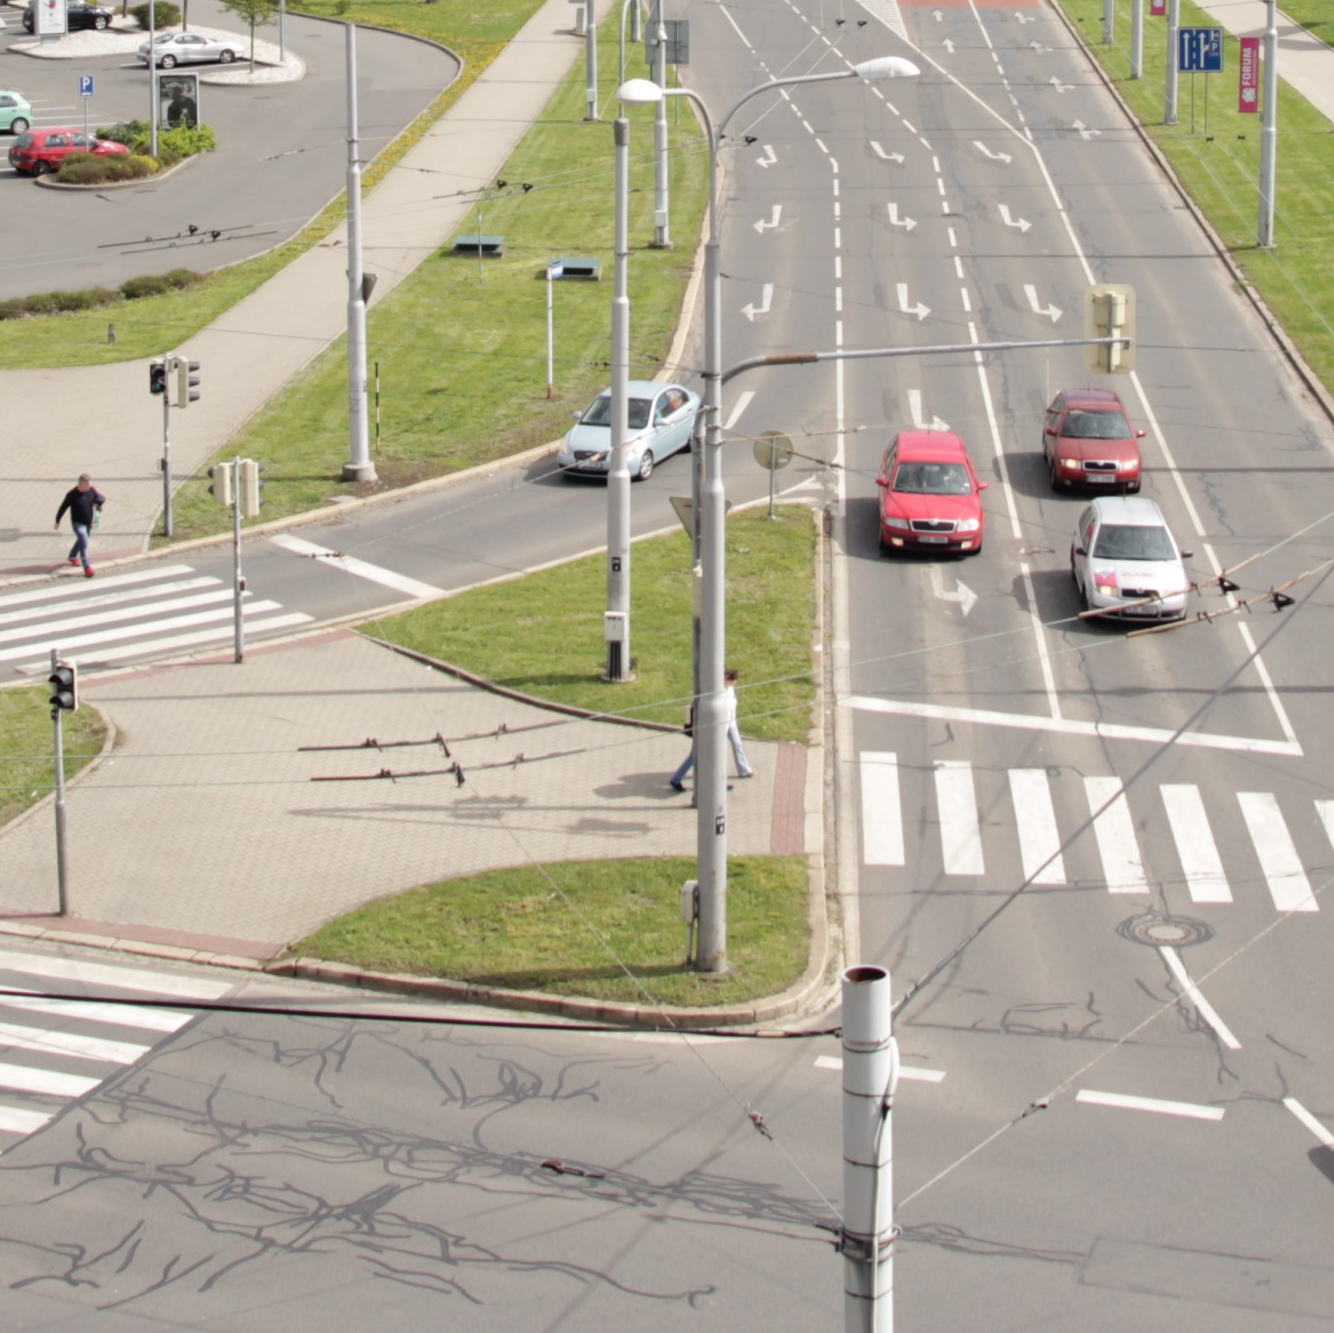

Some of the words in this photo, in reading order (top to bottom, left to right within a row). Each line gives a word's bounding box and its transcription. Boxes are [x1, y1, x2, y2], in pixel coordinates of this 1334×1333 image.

[1212, 43, 1218, 52] P
[1242, 48, 1252, 86] FORUM
[82, 77, 91, 91] P
